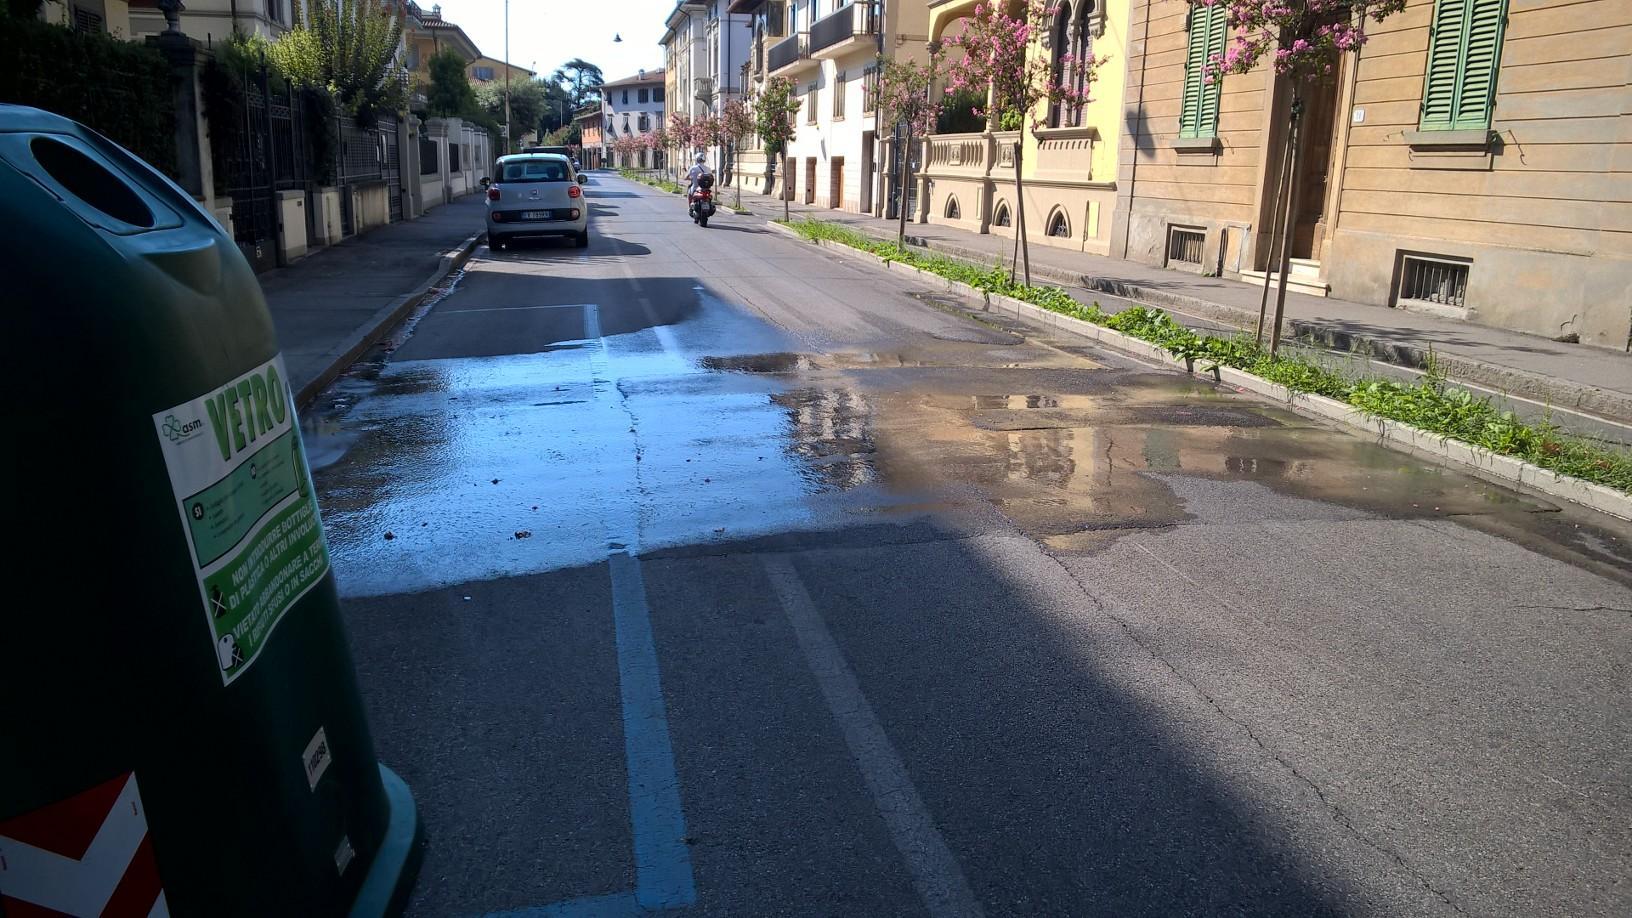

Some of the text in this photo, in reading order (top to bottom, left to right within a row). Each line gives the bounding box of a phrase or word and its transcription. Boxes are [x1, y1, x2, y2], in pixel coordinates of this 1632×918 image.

[181, 418, 203, 434] asm
[204, 364, 286, 462] VETRO
[228, 592, 240, 610] DI
[264, 555, 269, 568] O
[270, 537, 288, 563] ALTRI
[232, 561, 248, 586] NON
[232, 602, 260, 638] VIETATO
[303, 551, 309, 563] A
[284, 584, 290, 596] O
[291, 575, 300, 590] IN
